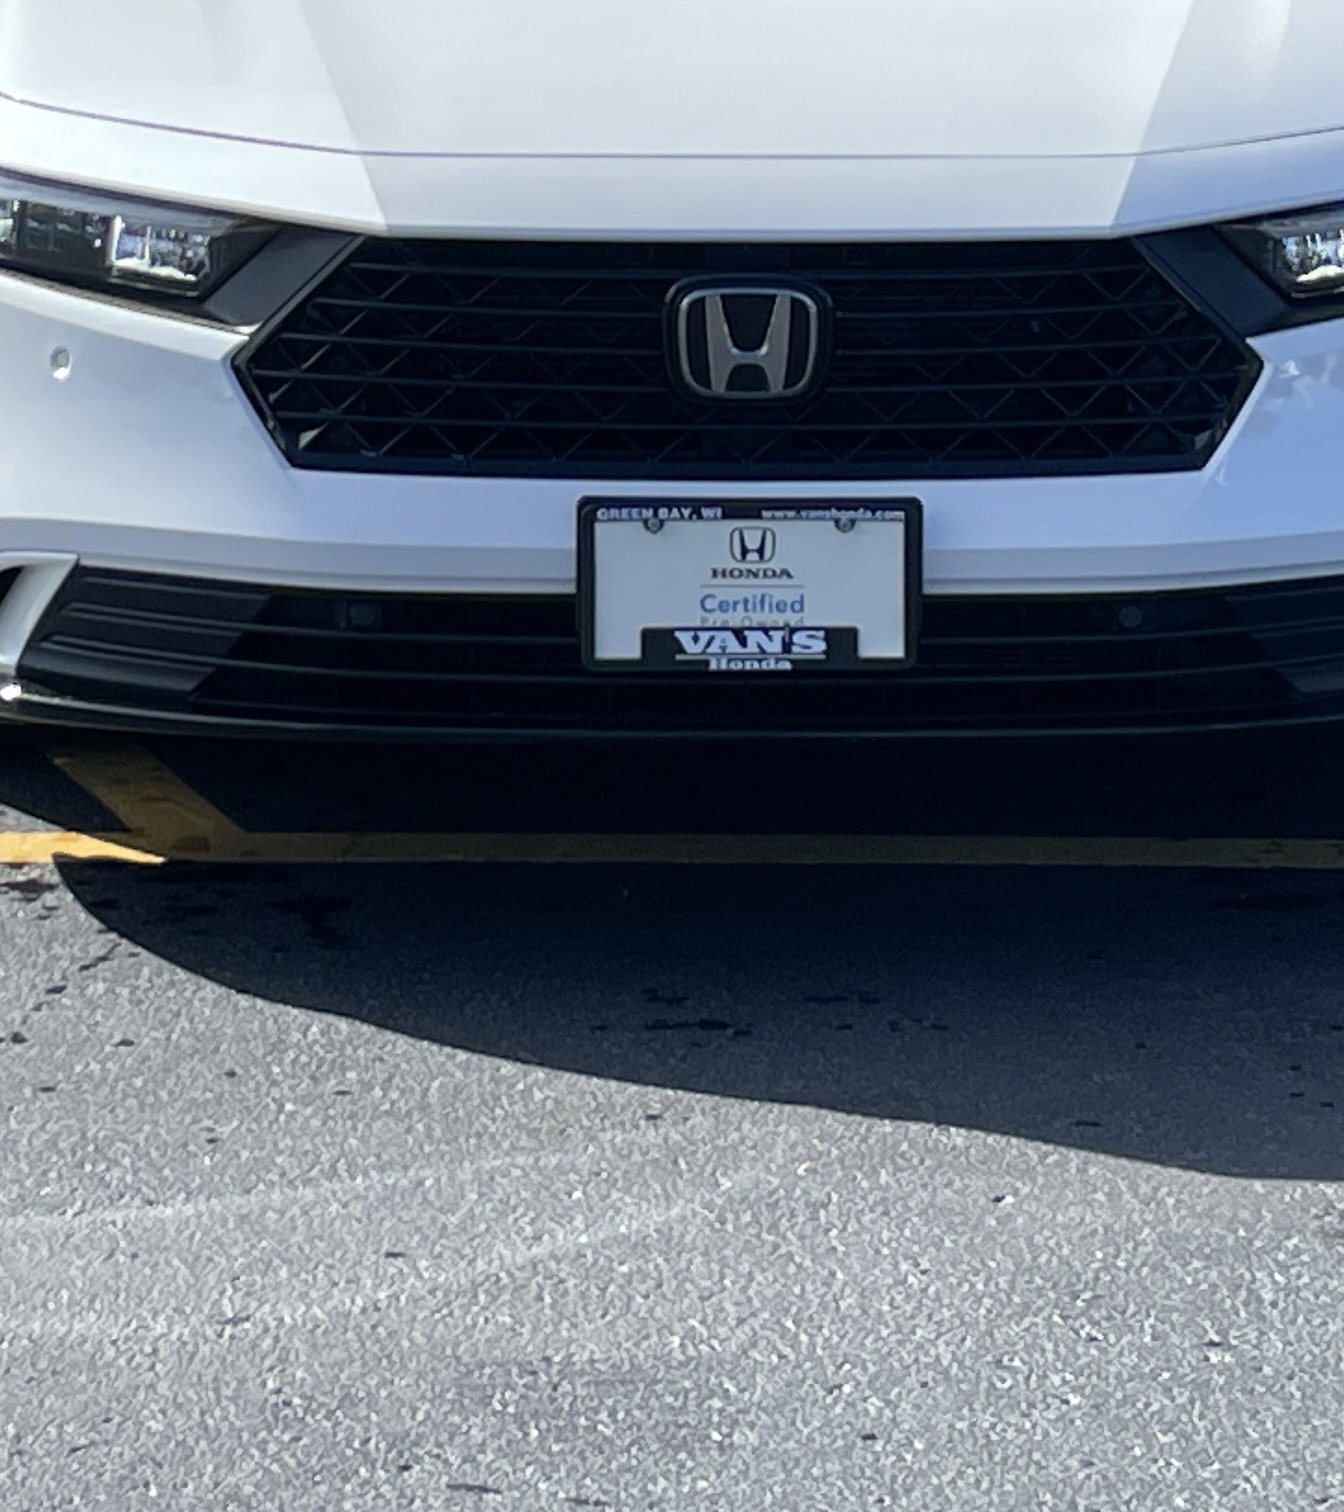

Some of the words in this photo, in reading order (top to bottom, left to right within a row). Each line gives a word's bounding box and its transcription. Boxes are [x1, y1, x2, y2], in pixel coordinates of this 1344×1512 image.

[596, 506, 654, 520] GREEN
[658, 506, 698, 521] BAY,
[701, 506, 723, 520] WI
[710, 567, 794, 579] HONDA
[699, 593, 804, 614] Certified
[674, 628, 827, 655] VAN'S
[708, 657, 793, 671] Honda
